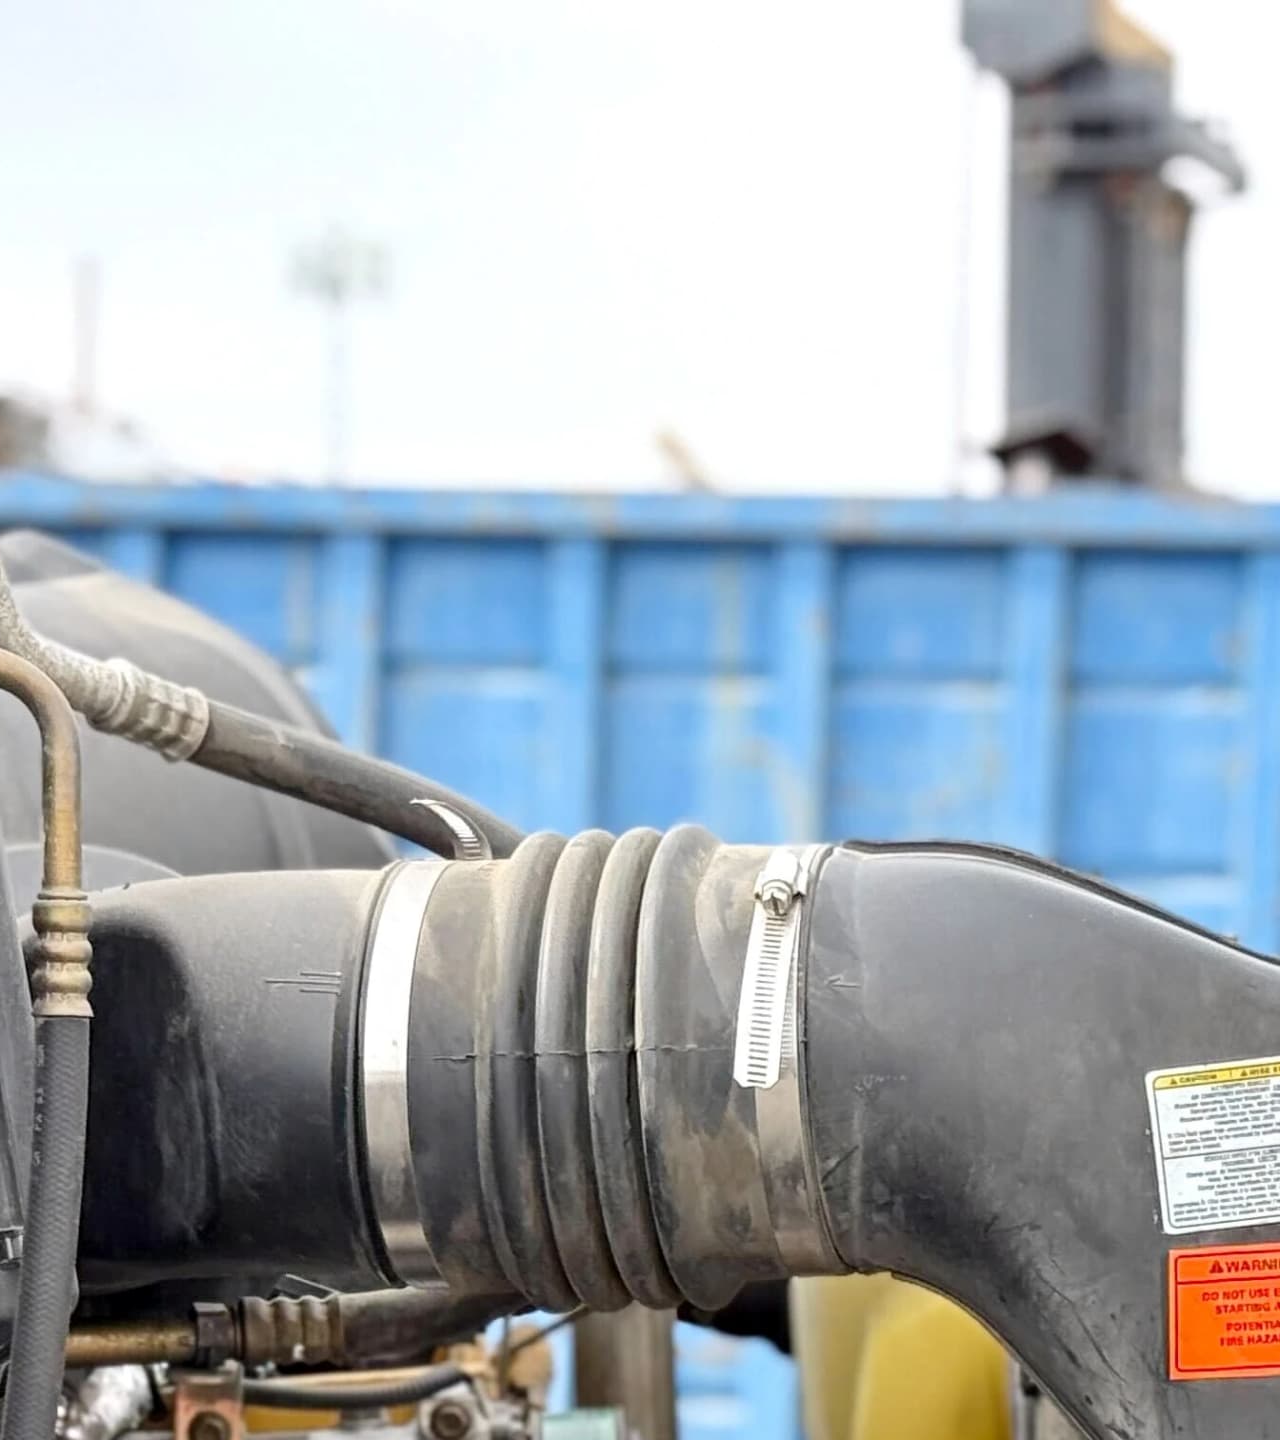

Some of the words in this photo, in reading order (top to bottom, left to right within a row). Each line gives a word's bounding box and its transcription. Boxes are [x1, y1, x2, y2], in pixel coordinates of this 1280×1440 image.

[1201, 1291, 1220, 1302] DO
[1222, 1289, 1247, 1300] NOT
[1248, 1287, 1271, 1299] USE
[1215, 1302, 1271, 1315] STARTING
[1220, 1335, 1245, 1347] FIRE
